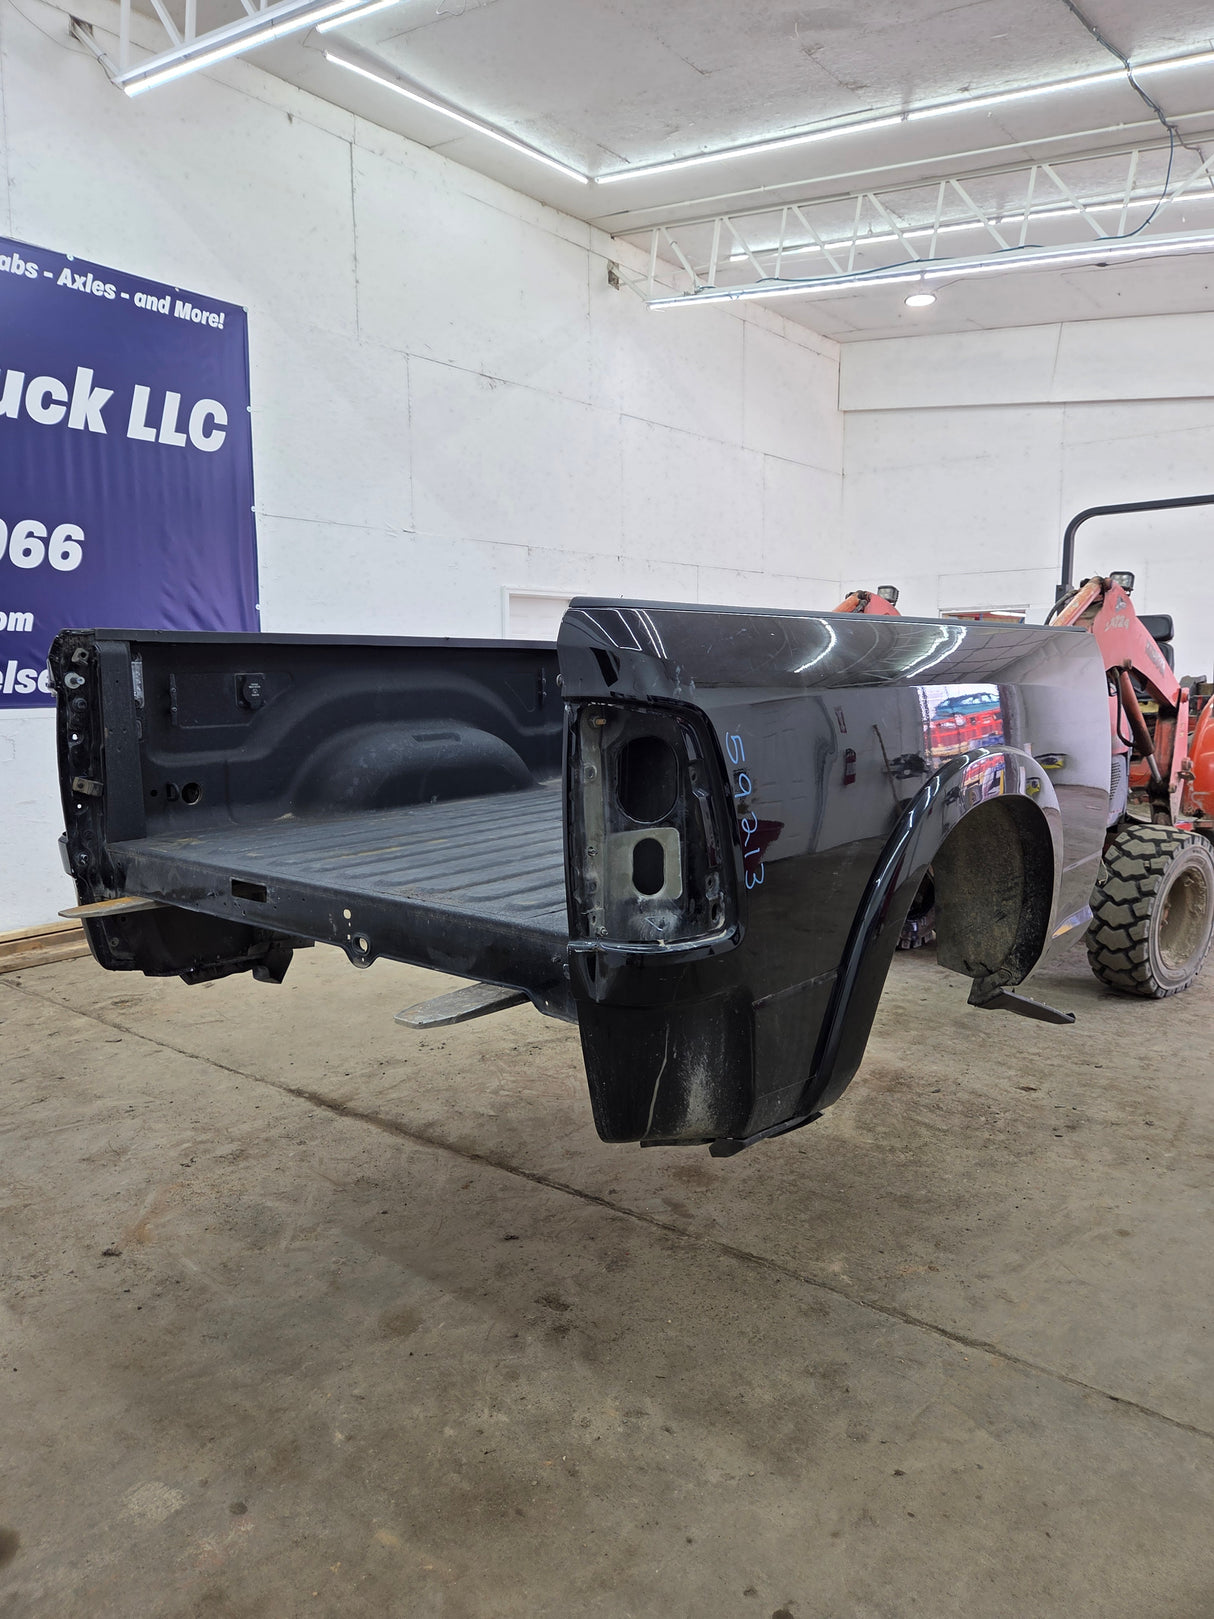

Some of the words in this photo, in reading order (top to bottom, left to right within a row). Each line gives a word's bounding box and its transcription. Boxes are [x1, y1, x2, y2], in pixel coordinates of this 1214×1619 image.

[43, 271, 54, 279] -
[57, 267, 117, 300] Axles
[121, 292, 131, 300] -
[134, 292, 171, 316] and
[174, 300, 226, 330] More!
[127, 384, 228, 452] LLC
